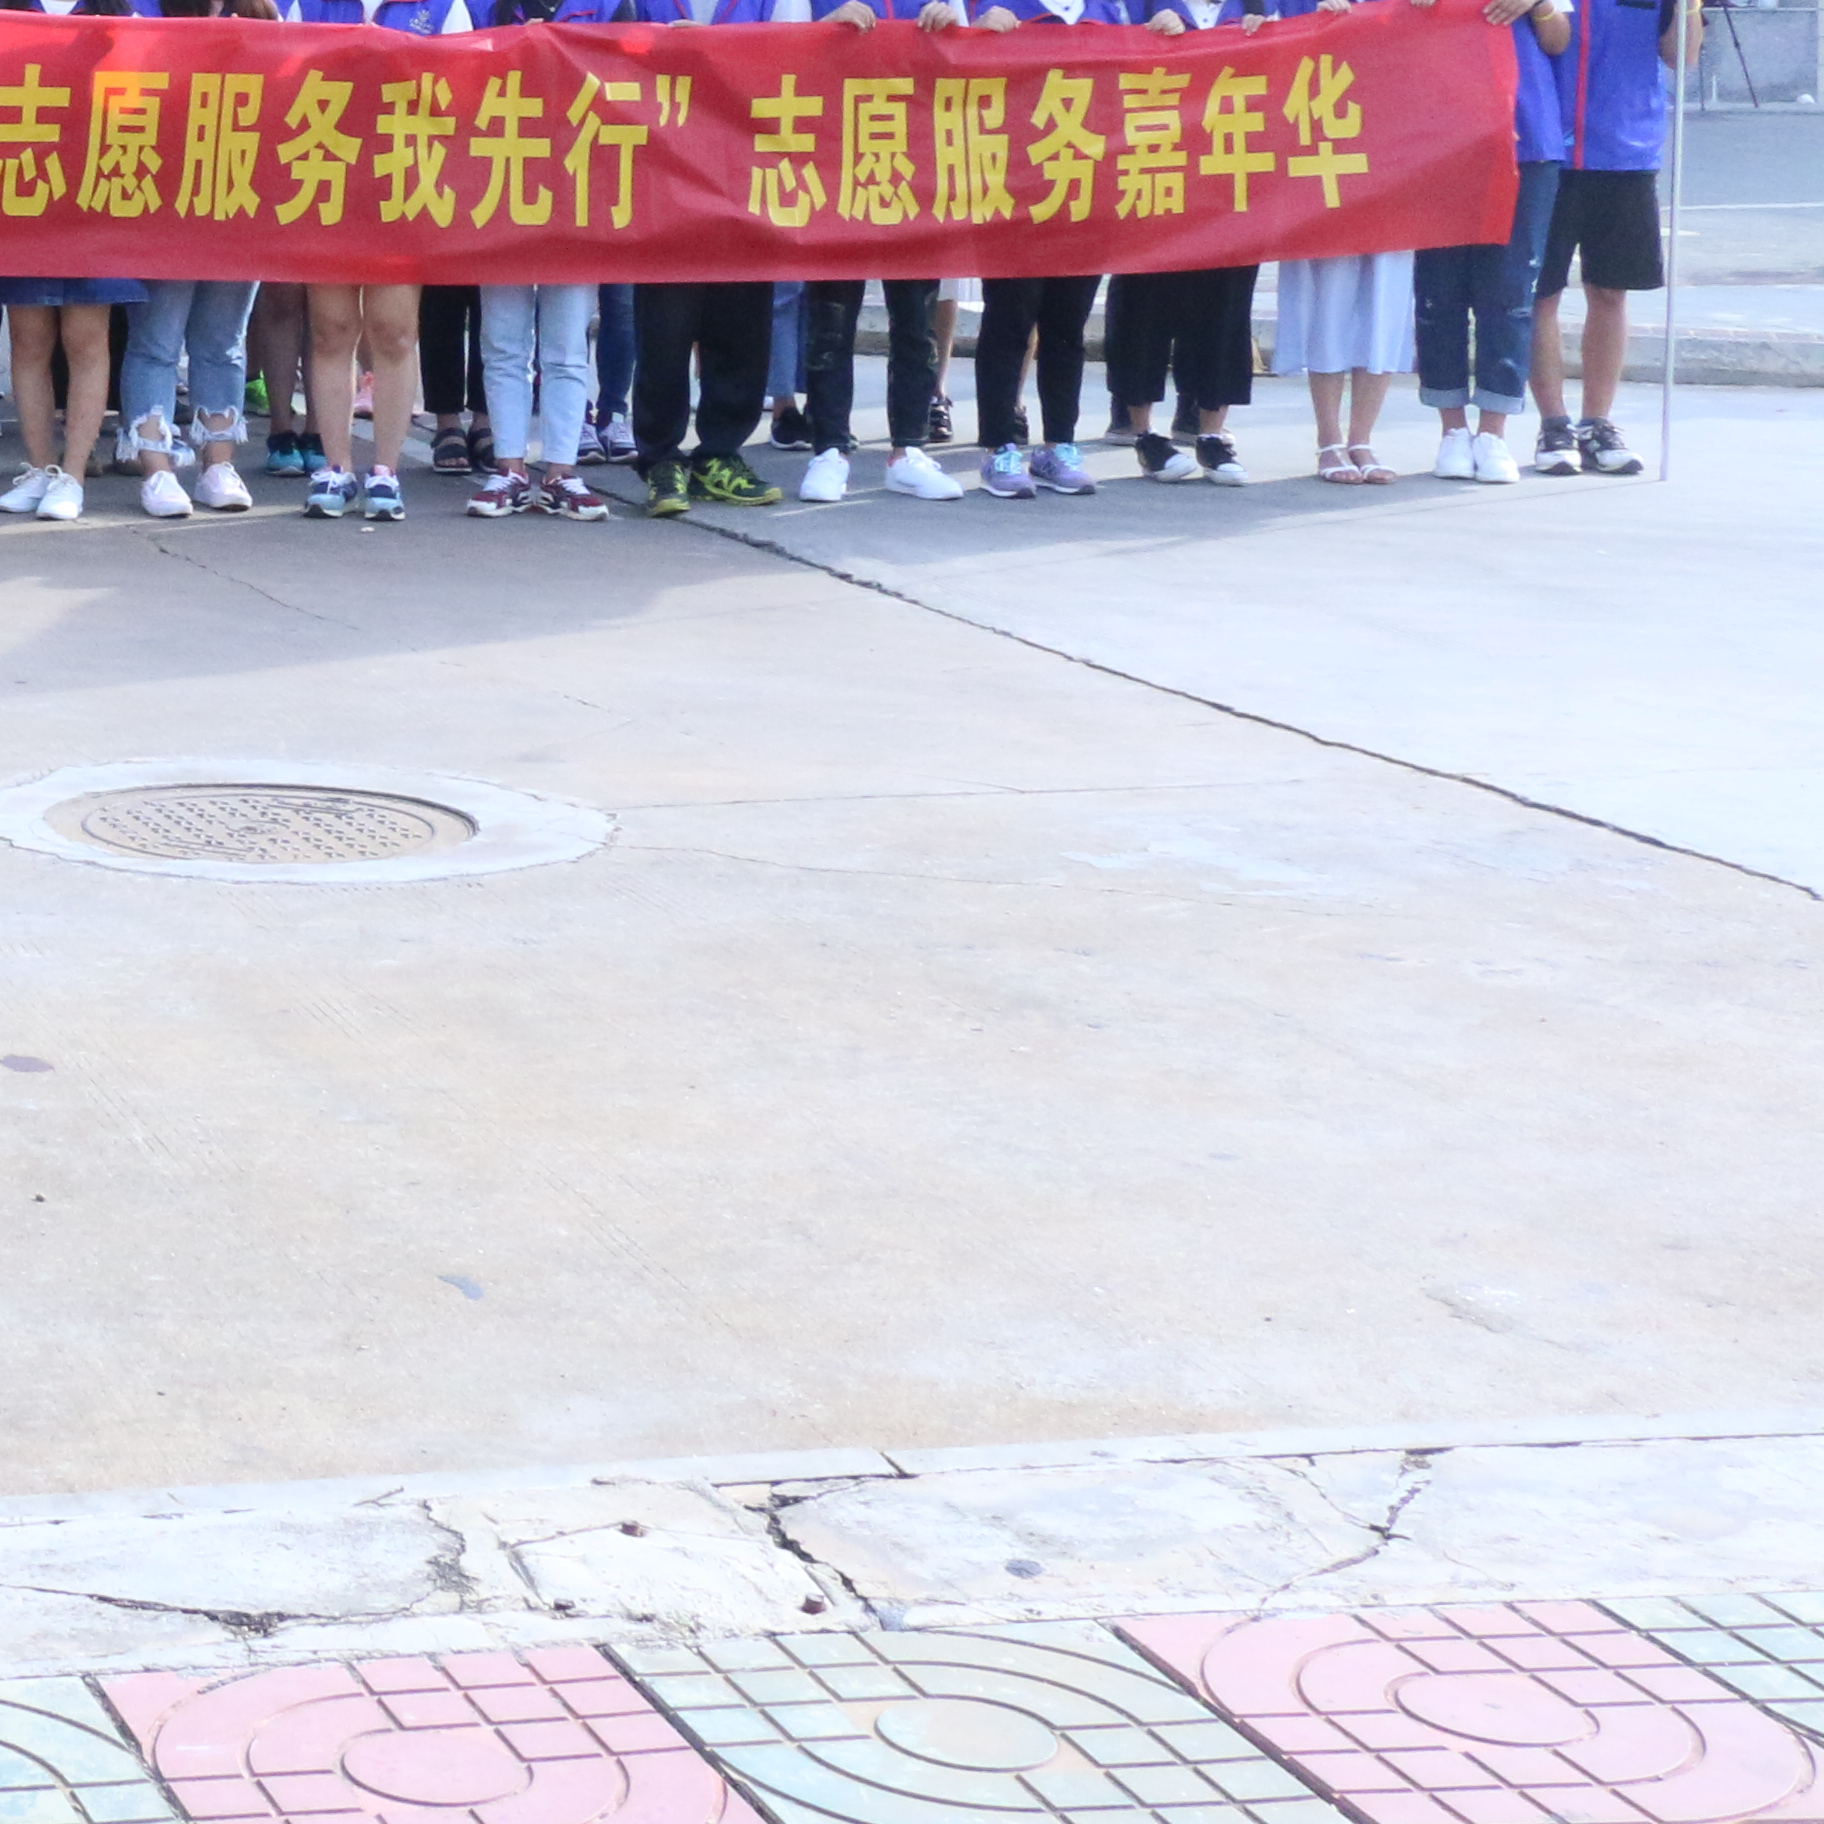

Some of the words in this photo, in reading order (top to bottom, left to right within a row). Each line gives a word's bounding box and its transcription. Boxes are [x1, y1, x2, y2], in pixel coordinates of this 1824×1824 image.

[747, 54, 1370, 228] 志愿服务嘉年华
